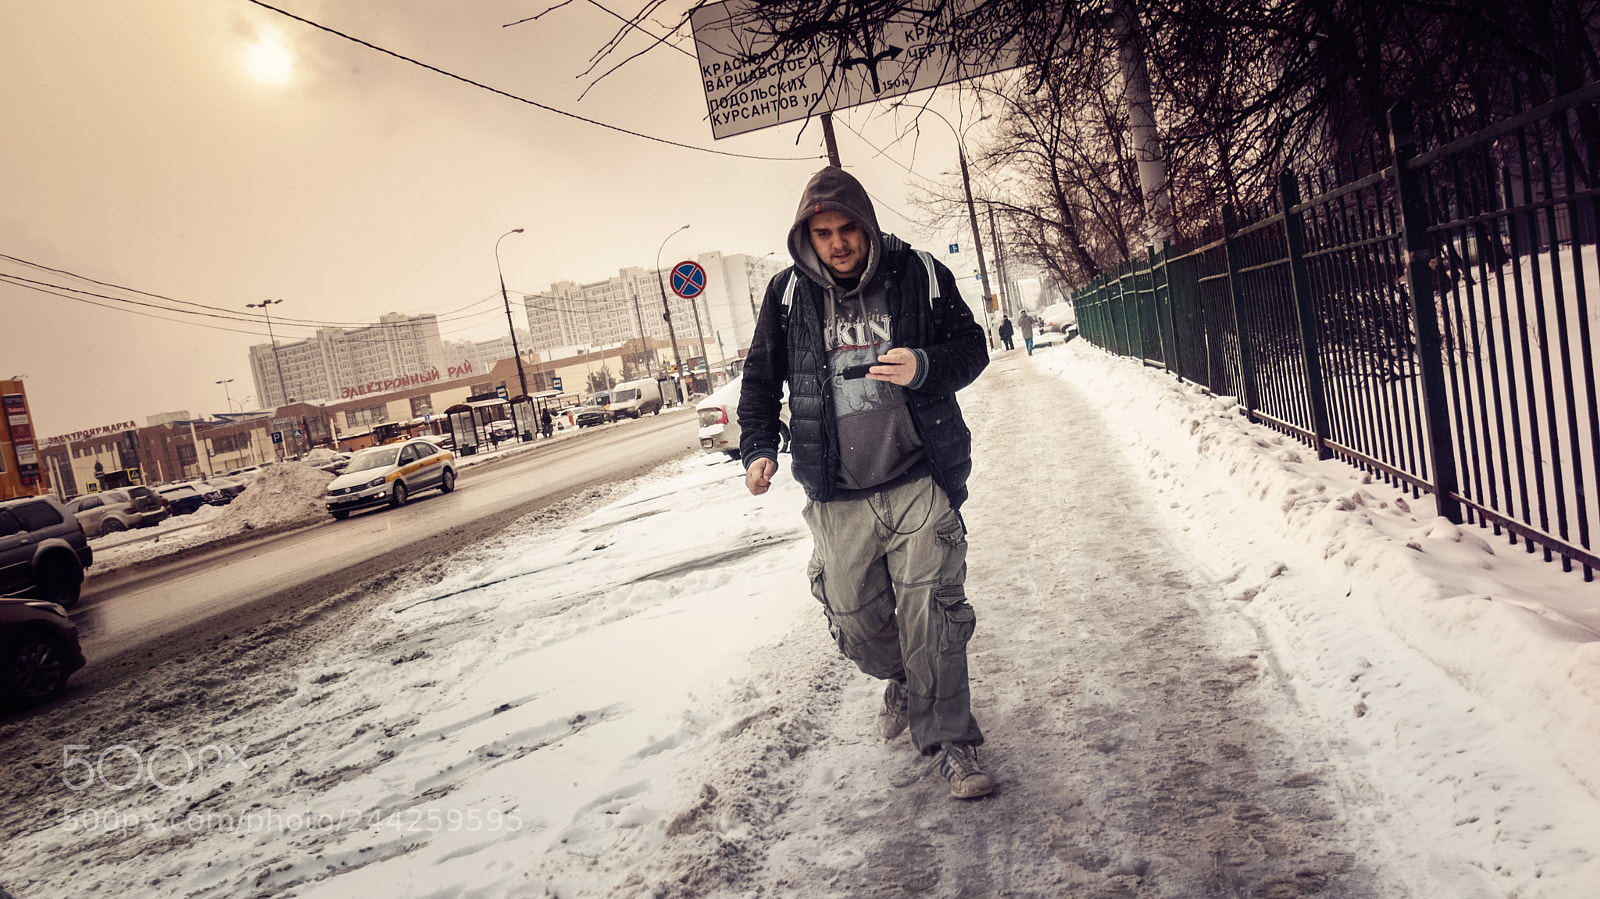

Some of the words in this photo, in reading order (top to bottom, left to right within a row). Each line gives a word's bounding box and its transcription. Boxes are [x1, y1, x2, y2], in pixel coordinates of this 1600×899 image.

[706, 59, 806, 92] ВАРШАВСКОЕ
[710, 78, 807, 111] ПОДОЛЬСКИХ
[712, 95, 798, 126] КУРСАНТОВ
[341, 366, 439, 399] ЭЛЕКТРОННЫЙ
[447, 359, 473, 377] РАЙ
[48, 420, 137, 445] ЭЛЕКТРОЯРМАРКА
